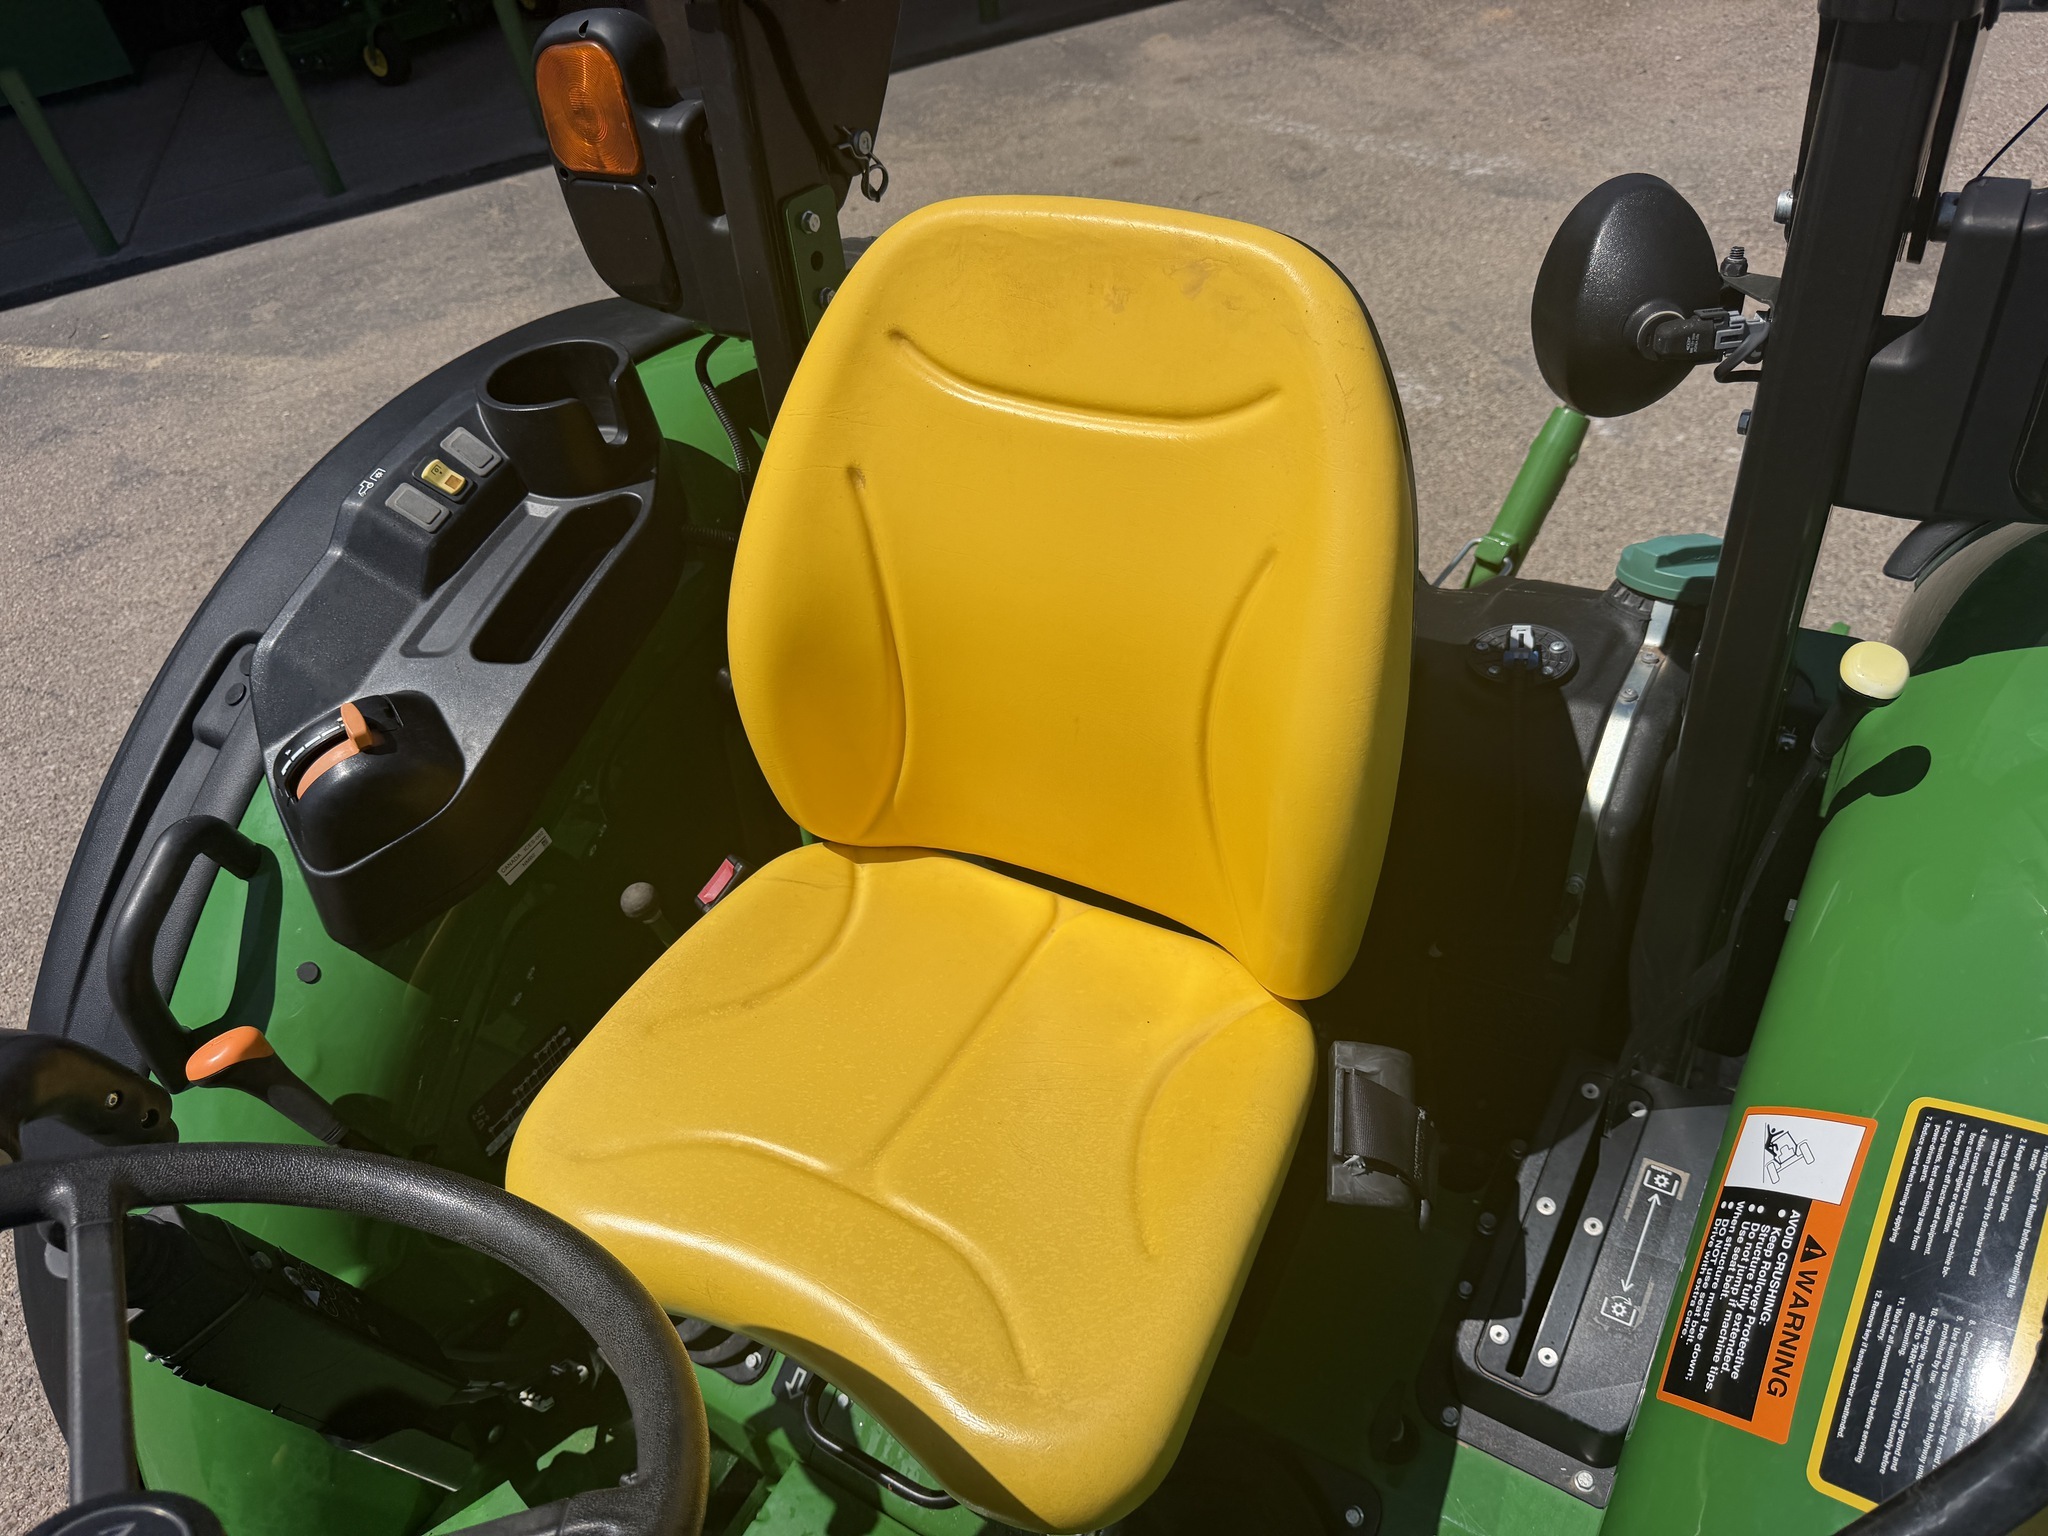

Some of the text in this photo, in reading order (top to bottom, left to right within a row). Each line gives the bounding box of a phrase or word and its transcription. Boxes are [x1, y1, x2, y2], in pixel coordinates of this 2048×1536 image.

[501, 853, 522, 873] CANADA
[1918, 1122, 1931, 1145] Reduce
[1940, 1126, 1951, 1143] Keep
[1953, 1129, 1965, 1146] Keep
[1975, 1135, 1986, 1152] Make
[1912, 1146, 1922, 1165] speed
[1919, 1124, 1941, 1182] power-driven parts.
[1934, 1143, 1946, 1164] hands,
[2000, 1141, 2011, 1158] Hitch
[2014, 1145, 2026, 1162] Keep
[2028, 1149, 2040, 1171] tractor.
[1931, 1165, 1940, 1177] feet
[1946, 1155, 1957, 1173] riders
[1969, 1152, 1980, 1174] certain
[1981, 1138, 1999, 1186] rearward upset.
[1994, 1158, 2005, 1179] towed
[2012, 1161, 2020, 1171] all
[1907, 1165, 1916, 1182] when
[1927, 1177, 1935, 1190] and
[1942, 1132, 1977, 1233] fore starting engine or operation.
[2006, 1171, 2018, 1194] shields
[1899, 1183, 1912, 1206] turning
[1938, 1184, 1949, 1206] tractor
[1961, 1174, 1974, 1204] everyone
[1989, 1178, 2000, 1197] loads
[2030, 1169, 2046, 1203] Operator's
[1898, 1206, 1904, 1214] or
[1918, 1190, 1932, 1217] clothing
[1934, 1206, 1942, 1220] and
[1984, 1197, 1994, 1212] only
[1998, 1202, 2009, 1222] place.
[1913, 1217, 1924, 1234] away
[1955, 1212, 1964, 1229] clear
[1983, 1212, 1991, 1220] to
[2024, 1203, 2037, 1228] Manual
[1889, 1214, 1902, 1243] applying
[1923, 1219, 1938, 1255] equipment.
[1952, 1229, 1959, 1237] of
[1976, 1220, 1988, 1248] drawbar
[2018, 1228, 2031, 1250] before
[1910, 1235, 1920, 1250] from
[1944, 1237, 1957, 1266] machine
[1973, 1248, 1982, 1256] to
[1719, 1221, 1751, 1300] Use seat belt.
[1759, 1209, 1801, 1326] AVOID CRUSHING:
[1942, 1266, 1950, 1277] be-
[1968, 1256, 1978, 1276] avoid
[2008, 1251, 2023, 1284] operating
[1680, 1218, 1722, 1338] Drive with extra care.
[1685, 1219, 1730, 1345] DO NOT use seat belt.
[1685, 1201, 1745, 1381] When structure must be down;
[1720, 1224, 1771, 1373] Structure fully extended.
[1874, 1290, 1882, 1299] 12.
[1897, 1297, 1905, 1306] 11.
[2006, 1284, 2016, 1298] this
[1704, 1222, 1760, 1392] Do not jump if machine tips.
[1731, 1227, 1782, 1379] Keep Rollover Protective
[1866, 1300, 1880, 1328] Remove
[1877, 1304, 1892, 1341] machinery.
[1892, 1308, 1903, 1323] Wait
[1766, 1270, 1818, 1397] WARNING
[1861, 1328, 1872, 1341] key
[1890, 1324, 1898, 1335] for
[1898, 1312, 1916, 1356] dismounting.
[1951, 1327, 1961, 1341] Use
[1929, 1323, 1949, 1383] prohibited by law.
[1960, 1331, 1974, 1357] Couple
[1853, 1347, 1867, 1373] leaving
[1877, 1344, 1891, 1381] movement
[1941, 1342, 1958, 1371] flashing
[1955, 1357, 1966, 1378] brake
[1848, 1373, 1859, 1397] tractor
[1875, 1381, 1883, 1389] to
[1879, 1315, 1925, 1474] shift to "PARK" or set brake(s) securely before
[1890, 1308, 1939, 1472] 10. Stop engine, lower implement to ground and
[1934, 1371, 1948, 1400] warning
[1947, 1377, 1961, 1402] pedals
[1870, 1389, 1879, 1406] stop
[1836, 1397, 1852, 1438] unattended.
[1864, 1406, 1876, 1429] before
[1930, 1400, 1942, 1421] lights
[1941, 1403, 1955, 1435] together
[1928, 1422, 1935, 1432] on
[1854, 1430, 1869, 1463] servicing
[1918, 1433, 1934, 1464] highway
[1938, 1434, 1947, 1446] for
[1933, 1446, 1943, 1465] road
[1915, 1464, 1924, 1480] unle
